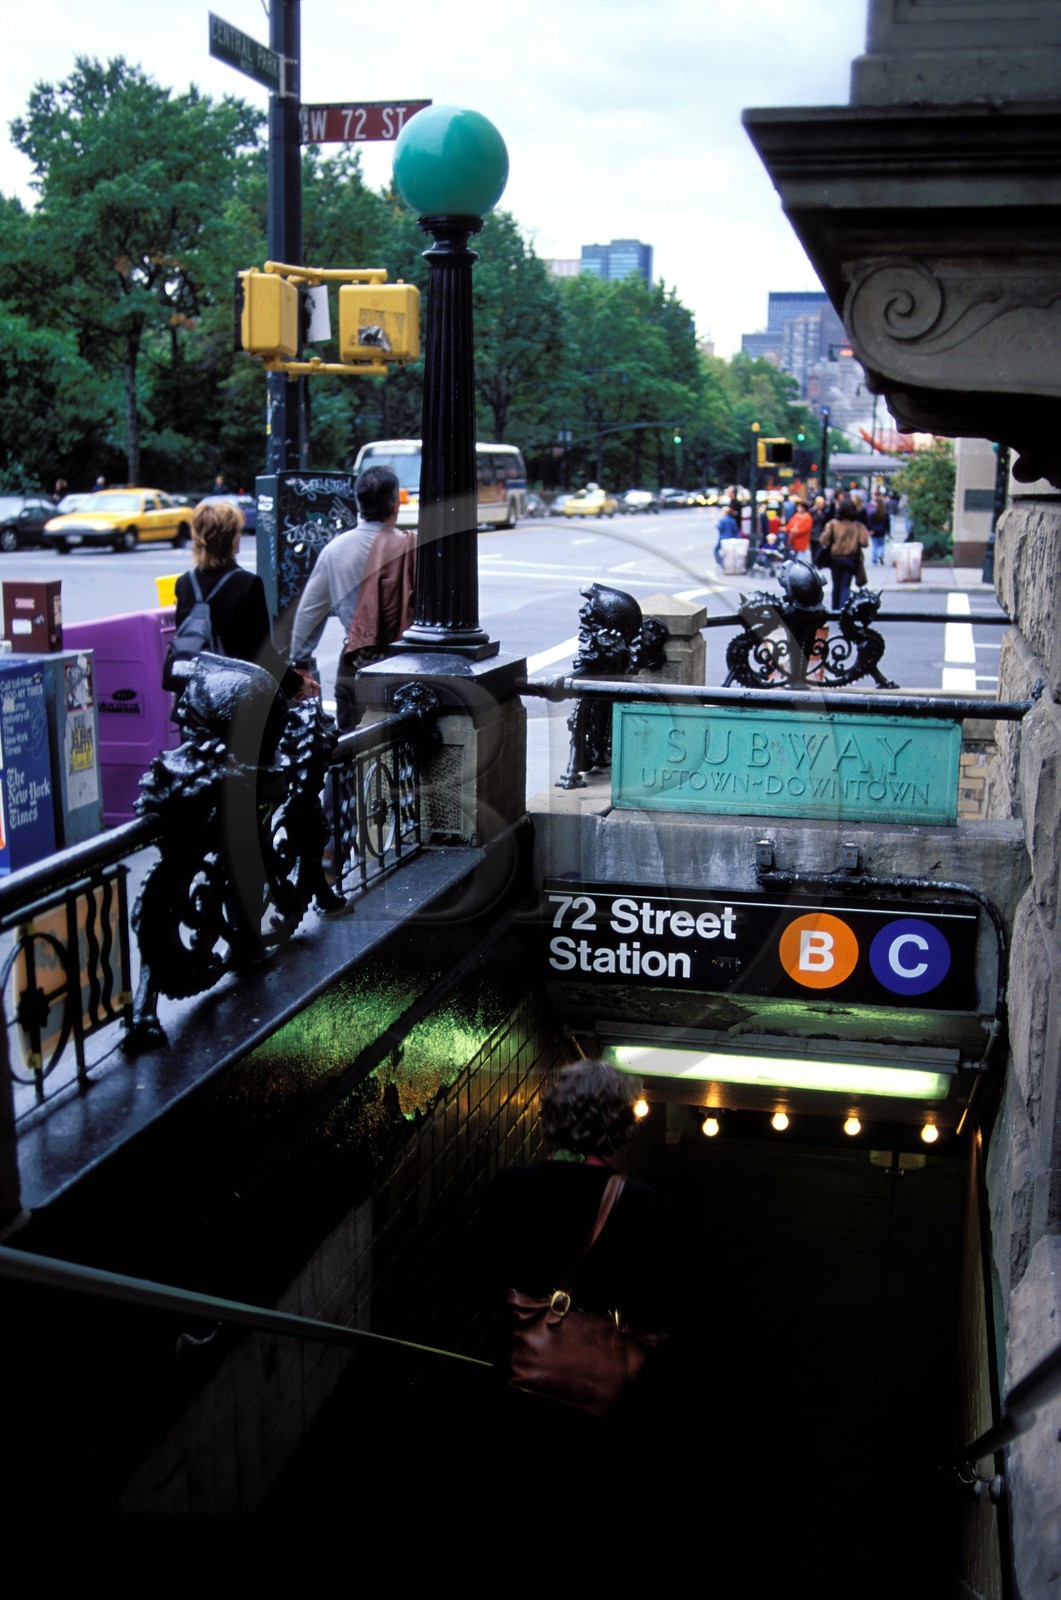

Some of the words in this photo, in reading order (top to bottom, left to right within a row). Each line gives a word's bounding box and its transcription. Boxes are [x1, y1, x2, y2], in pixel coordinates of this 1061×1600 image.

[211, 17, 254, 63] CENTRAL
[256, 46, 280, 80] PARK
[310, 110, 328, 141] W
[341, 108, 367, 140] 72
[382, 106, 407, 139] ST
[0, 678, 11, 691] Call
[27, 684, 44, 697] TIMES
[3, 713, 24, 725] delivery
[3, 724, 14, 736] The
[4, 736, 17, 747] New
[17, 730, 29, 744] York
[4, 745, 22, 758] Times
[667, 727, 914, 776] SUBWAY
[6, 767, 25, 789] The
[640, 766, 931, 806] UPTOWN-DOWNTOWN
[8, 787, 28, 809] New
[29, 776, 51, 807] York
[9, 806, 39, 830] Times
[548, 895, 597, 931] 72
[610, 898, 737, 940] Street
[548, 936, 692, 979] Station
[798, 929, 836, 973] B
[888, 933, 930, 979] C
